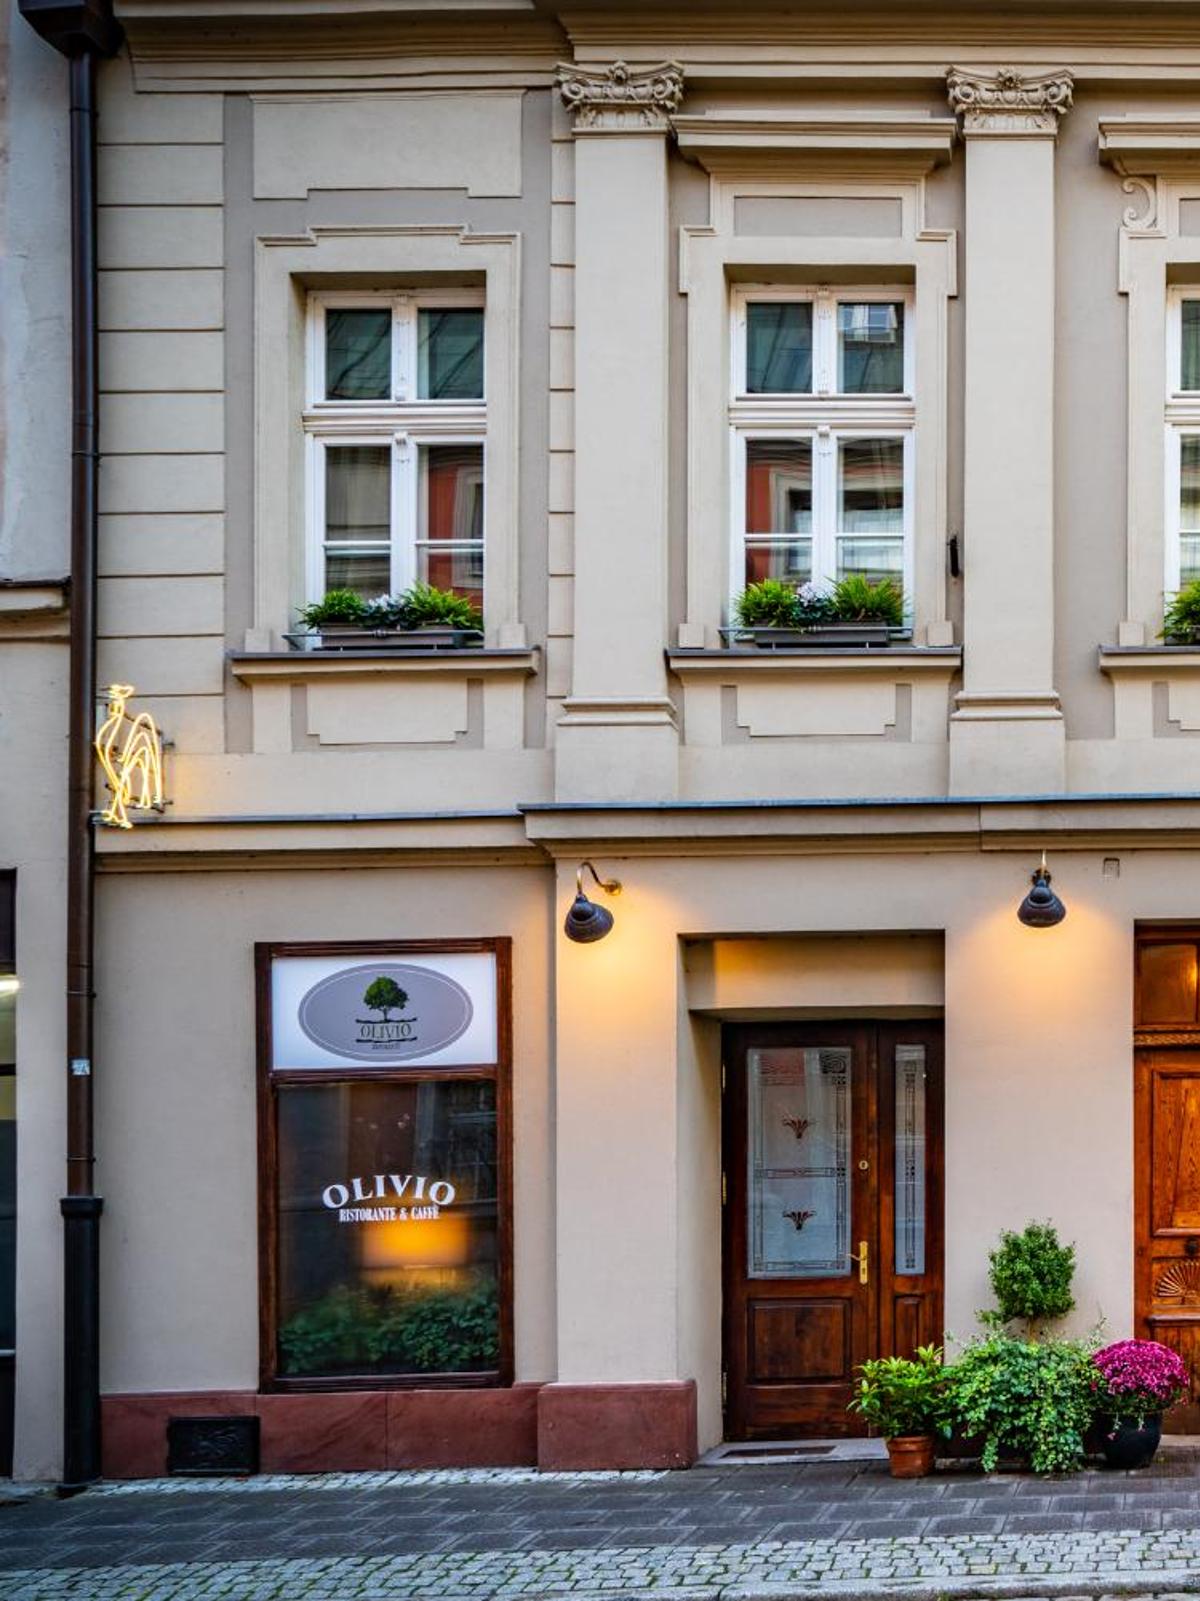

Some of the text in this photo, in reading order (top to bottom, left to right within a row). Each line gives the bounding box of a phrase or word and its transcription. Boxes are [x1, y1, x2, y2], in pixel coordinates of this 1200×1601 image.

[361, 1023, 411, 1038] OLIVIO
[322, 1174, 455, 1208] OLIVIO
[339, 1207, 397, 1222] RISTORANTE
[399, 1207, 408, 1220] &
